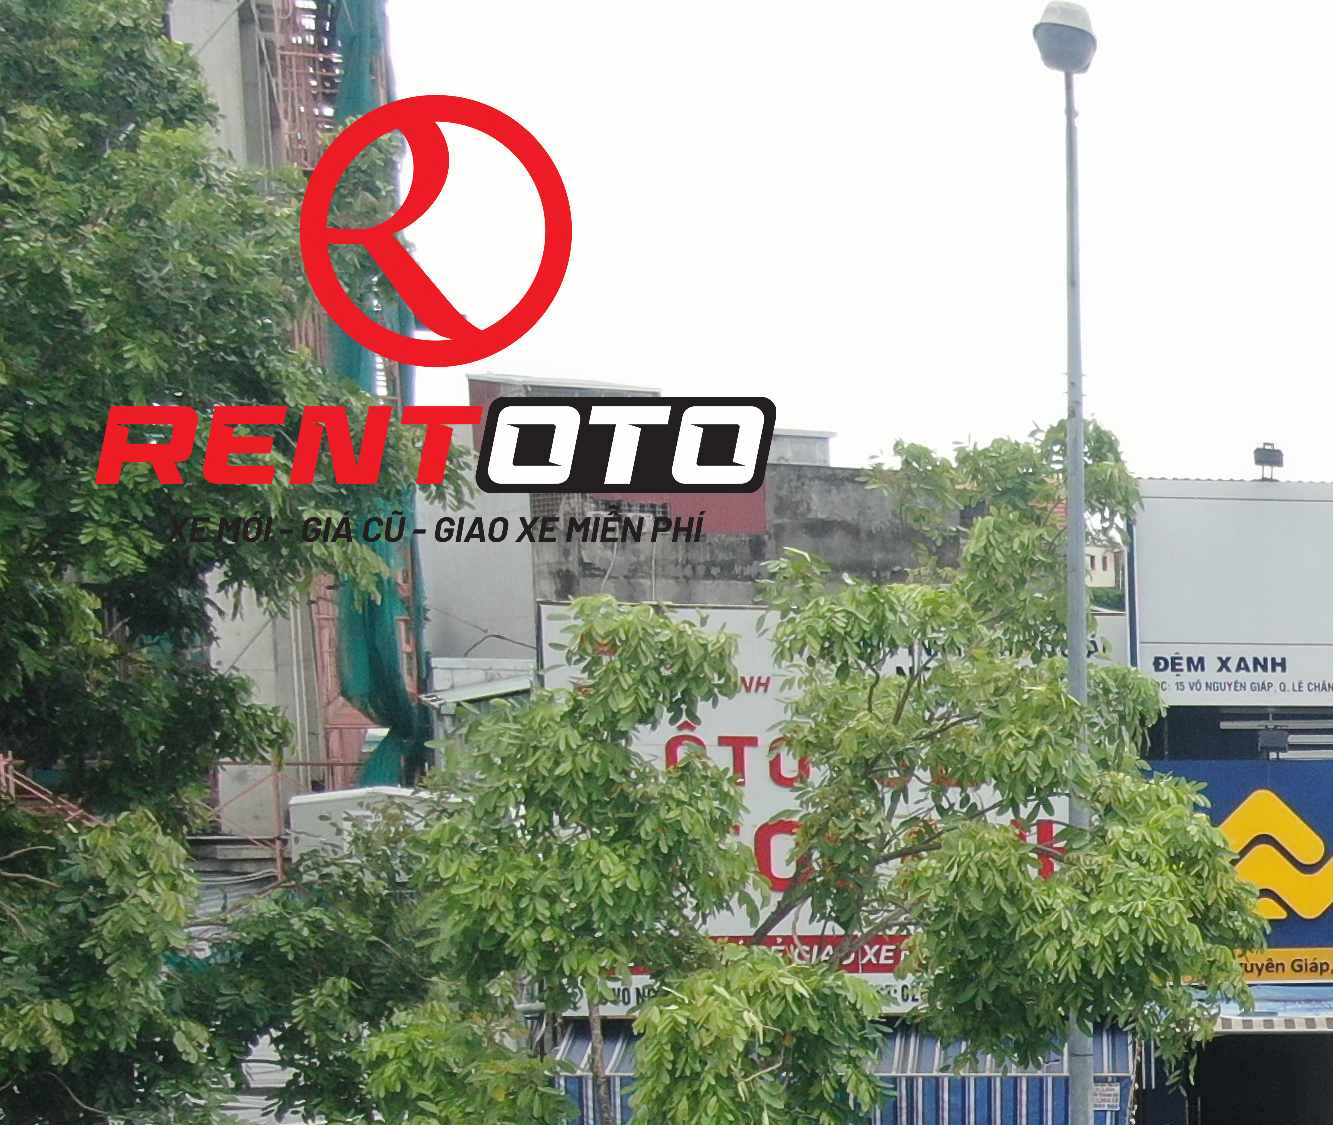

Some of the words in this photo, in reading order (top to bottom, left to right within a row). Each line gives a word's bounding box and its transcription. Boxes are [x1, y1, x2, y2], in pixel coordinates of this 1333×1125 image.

[1152, 652, 1206, 677] ĐỆM
[1216, 656, 1287, 673] XANH
[1175, 681, 1186, 692] 15
[1240, 957, 1286, 976] uyên
